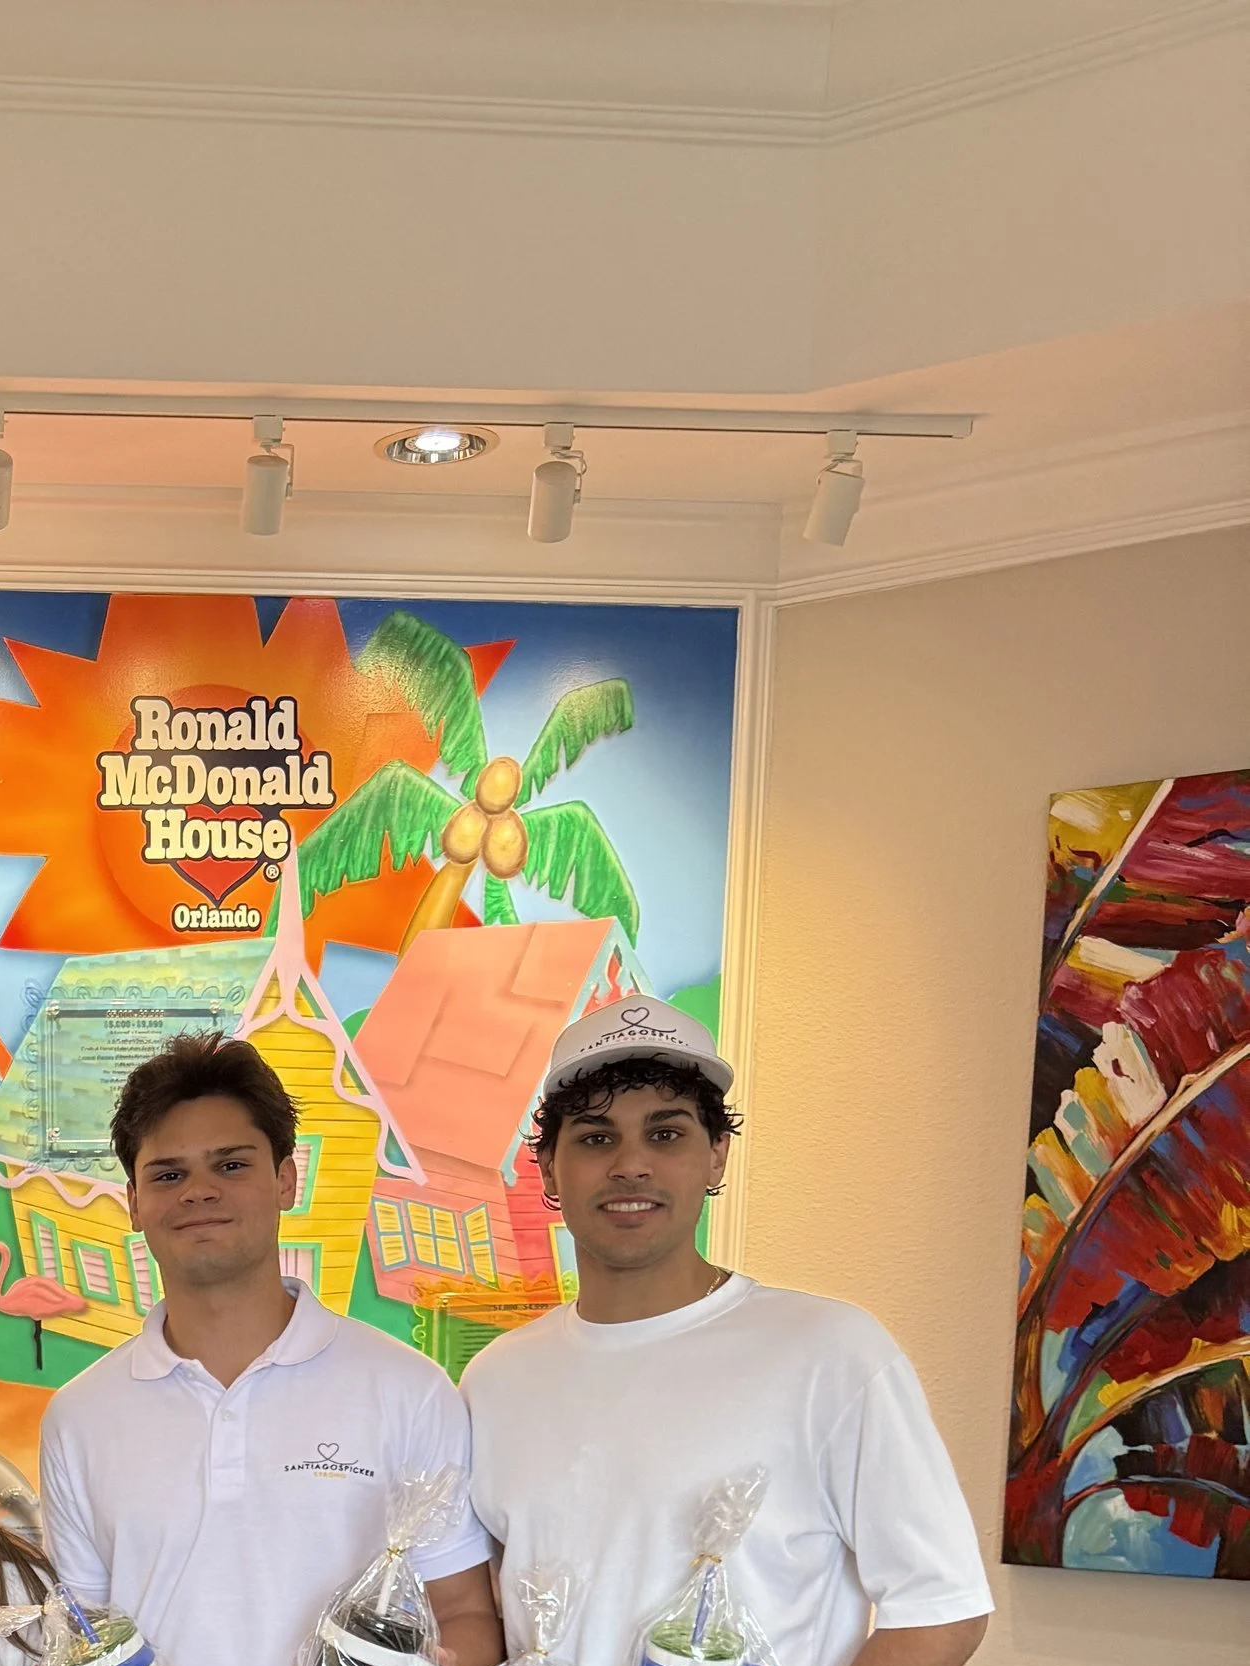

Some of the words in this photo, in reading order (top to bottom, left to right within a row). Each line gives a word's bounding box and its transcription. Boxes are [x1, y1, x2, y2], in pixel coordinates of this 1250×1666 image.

[134, 699, 300, 750] Ronald
[99, 754, 335, 806] McDonald
[144, 808, 289, 861] House
[173, 905, 260, 929] Orlando
[284, 1463, 374, 1477] SANTIAGOSPICKER
